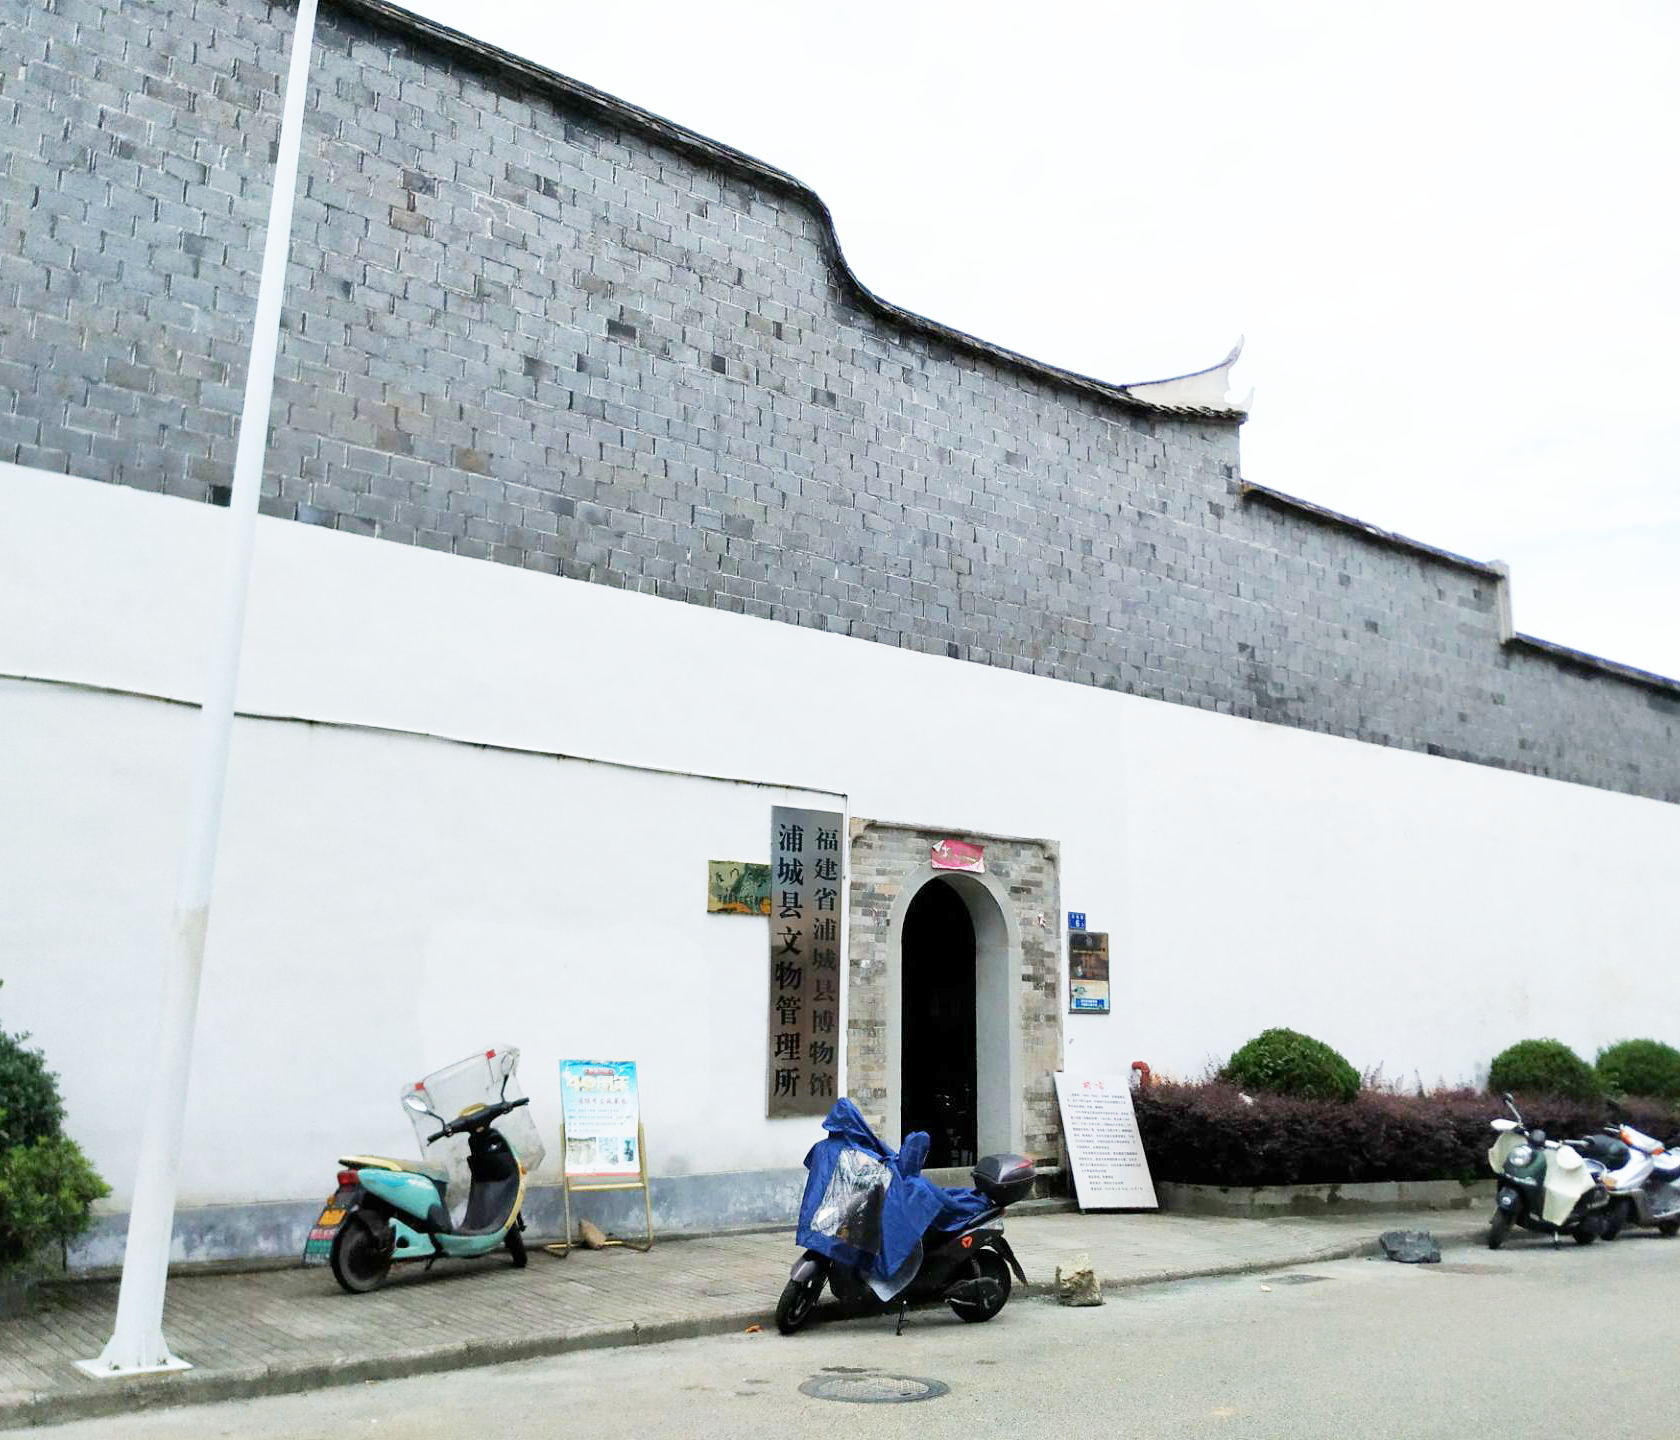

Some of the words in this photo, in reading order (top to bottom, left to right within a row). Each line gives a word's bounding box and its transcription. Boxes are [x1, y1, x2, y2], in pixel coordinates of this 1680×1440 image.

[774, 824, 804, 1097] 浦城县文物管理所
[809, 827, 838, 1097] 福建省浦城县博物馆
